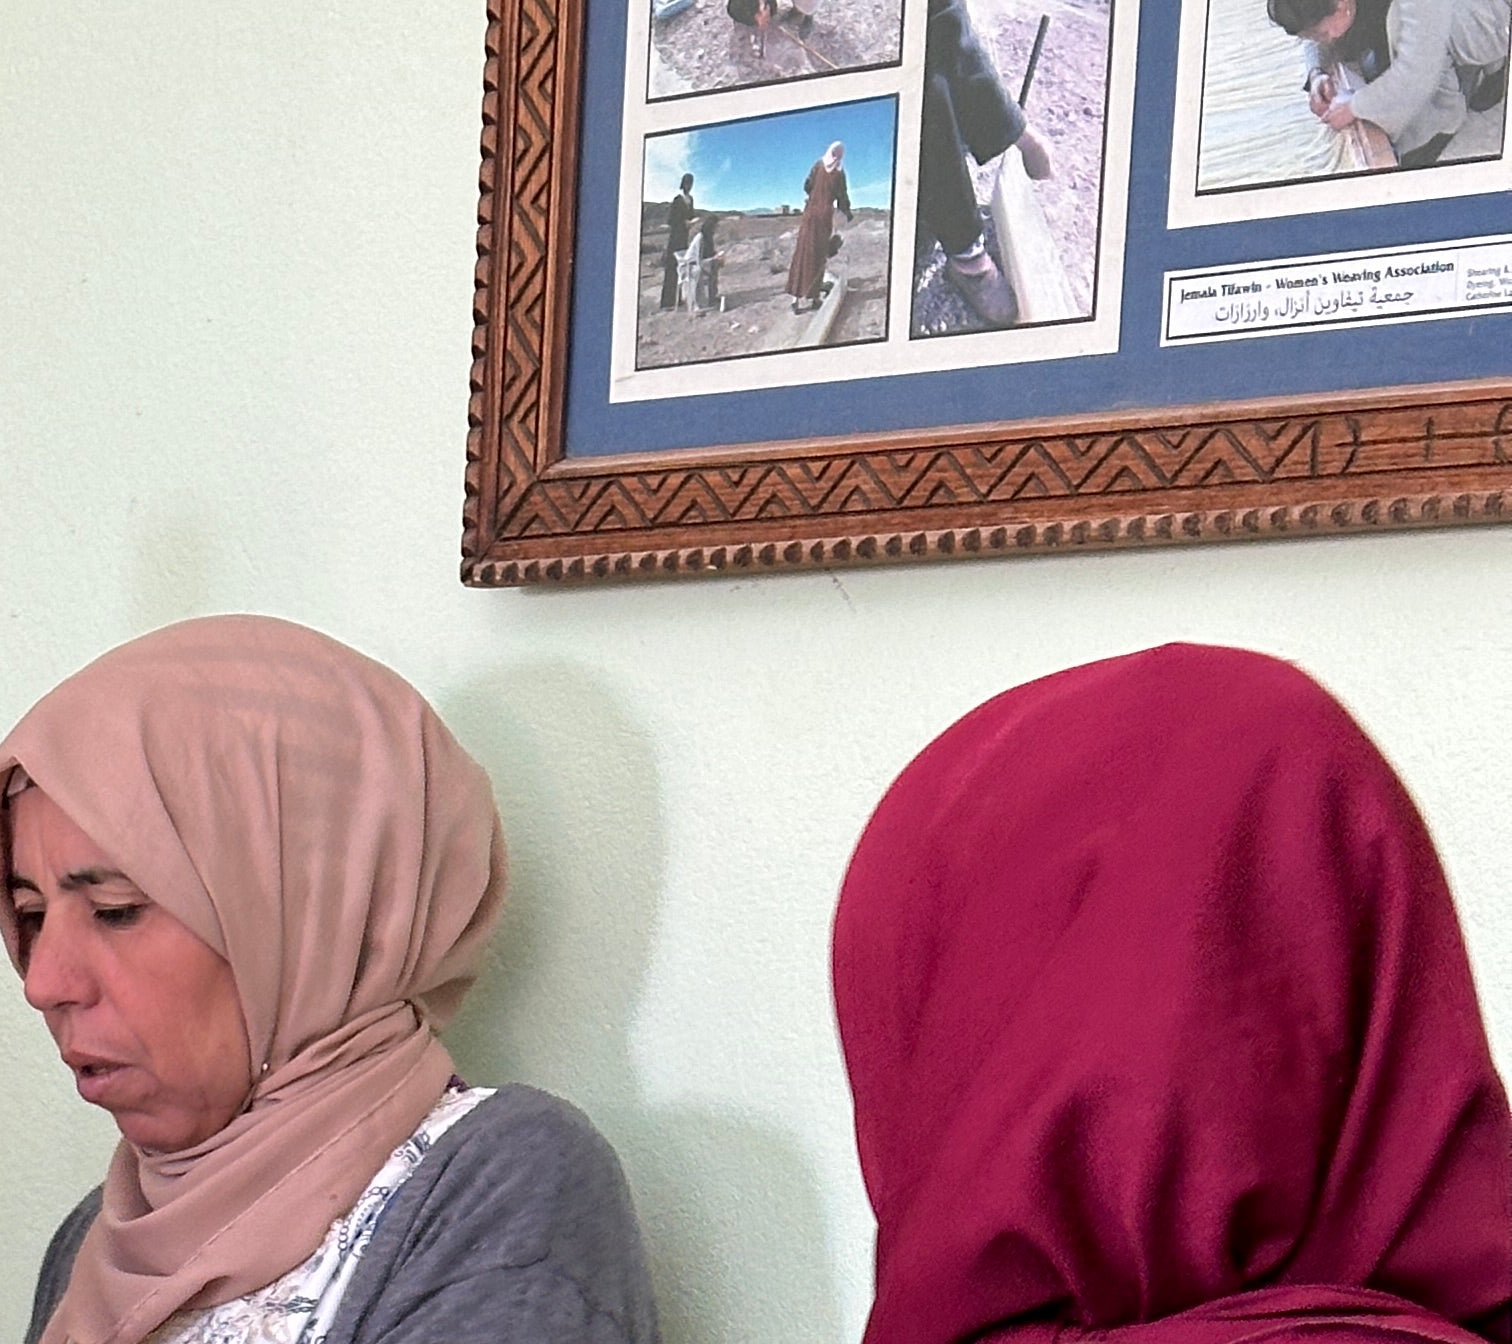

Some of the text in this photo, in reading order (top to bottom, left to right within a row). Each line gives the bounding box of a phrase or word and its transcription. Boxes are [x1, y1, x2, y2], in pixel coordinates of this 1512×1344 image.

[1181, 287, 1217, 303] Jemala
[1221, 281, 1262, 296] Tifawin
[1275, 274, 1328, 289] Women's
[1332, 268, 1381, 283] Weaving
[1385, 261, 1454, 278] Association
[1369, 286, 1414, 309] جمعية
